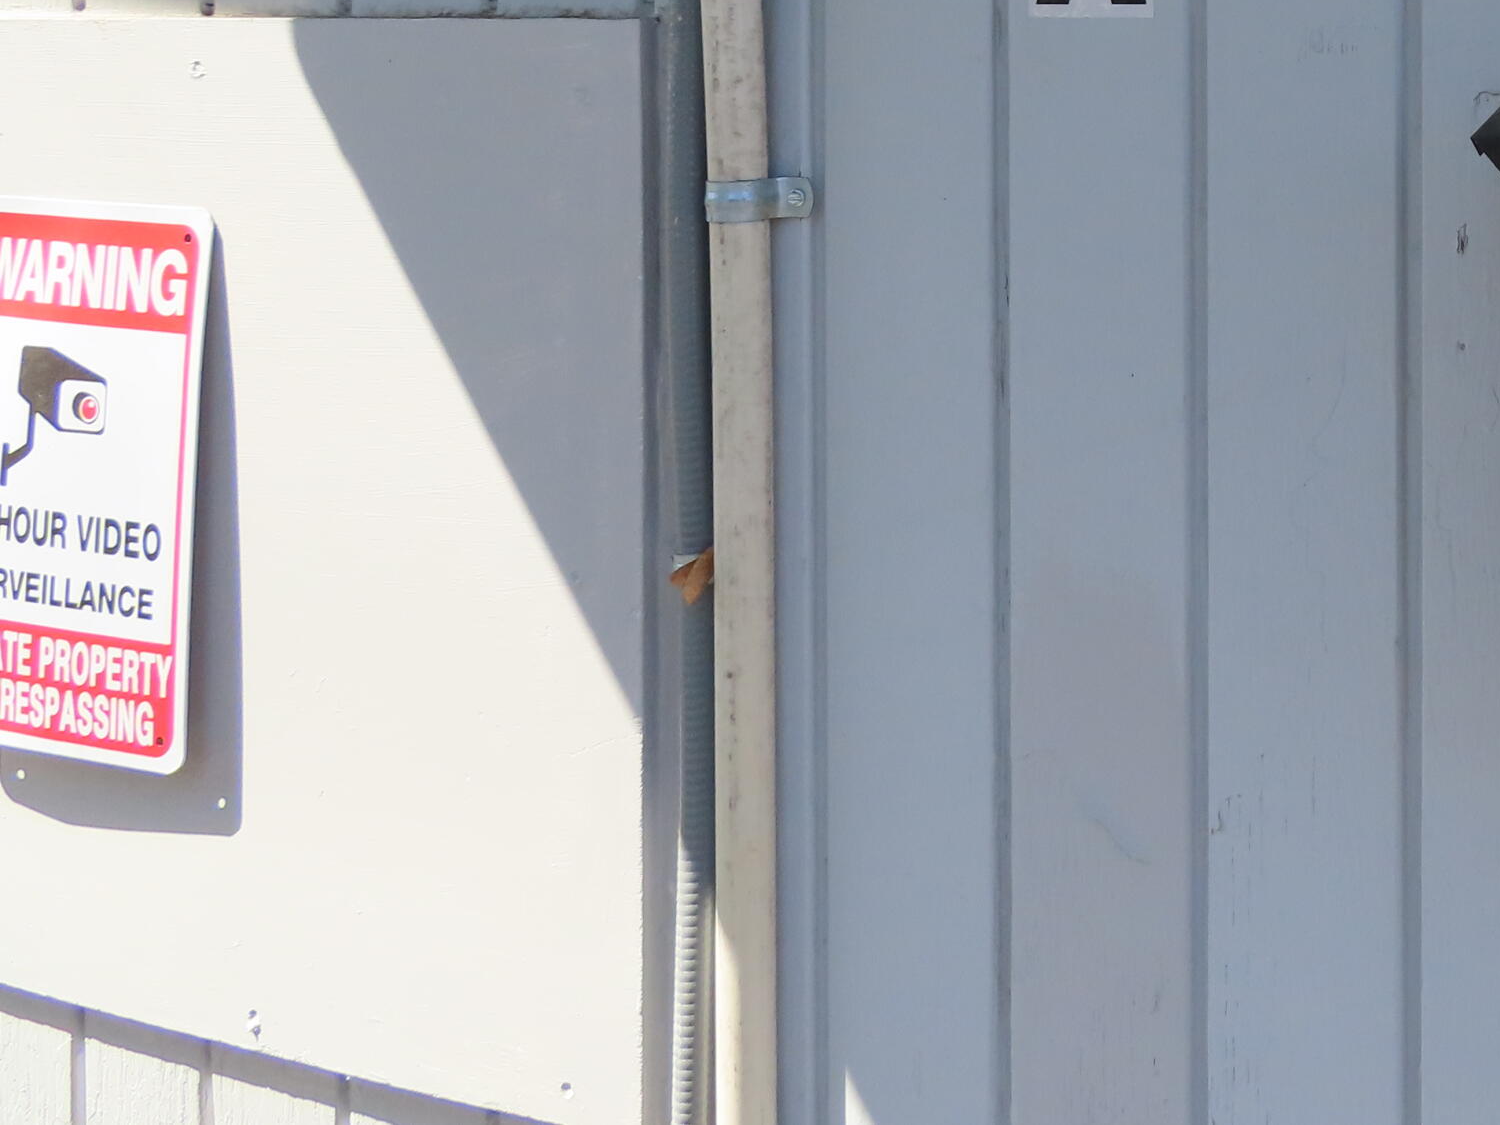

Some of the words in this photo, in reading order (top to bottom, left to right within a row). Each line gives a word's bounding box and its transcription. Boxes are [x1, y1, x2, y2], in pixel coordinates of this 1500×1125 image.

[0, 236, 188, 317] WARNING
[0, 503, 67, 550] HOUR
[77, 514, 161, 562] VIDEO
[0, 630, 33, 677] TE
[38, 636, 173, 698] PROPERTY
[0, 677, 154, 747] RESPASSING
